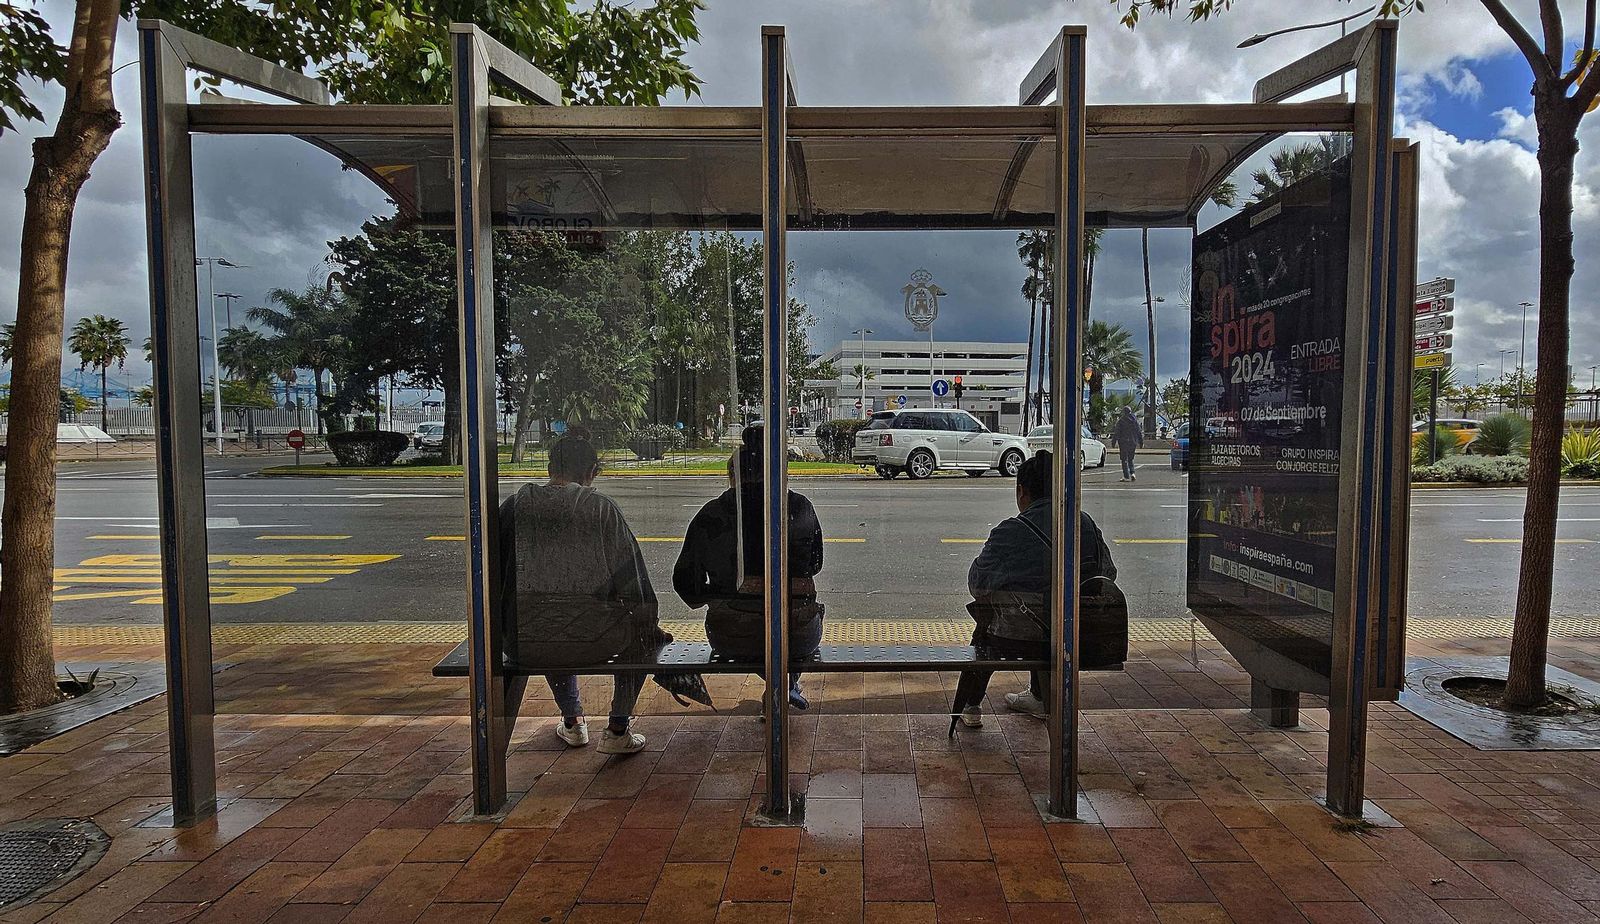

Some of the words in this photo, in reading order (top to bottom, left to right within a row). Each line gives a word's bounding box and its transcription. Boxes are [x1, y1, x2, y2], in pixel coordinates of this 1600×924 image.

[1427, 286, 1446, 294] Europa
[1262, 299, 1270, 309] 20
[1210, 306, 1276, 368] spira
[1290, 337, 1341, 360] ENTRADA
[1231, 350, 1276, 384] 2024
[1308, 355, 1342, 372] LIBRE
[1425, 356, 1444, 366] puerto
[1241, 407, 1253, 421] 07
[1253, 406, 1265, 421] de
[1265, 403, 1327, 424] Septiembre
[1211, 444, 1229, 456] PLAZA
[1228, 445, 1237, 456] DE
[1281, 448, 1306, 460] GRUPO
[1307, 448, 1340, 461] INSPIRA
[1211, 455, 1242, 467] ALGECIRAS
[1276, 460, 1291, 471] CON
[1291, 461, 1318, 473] JORGE
[1318, 463, 1340, 474] FELIZ
[1239, 543, 1315, 575] inspiraespaña.com
